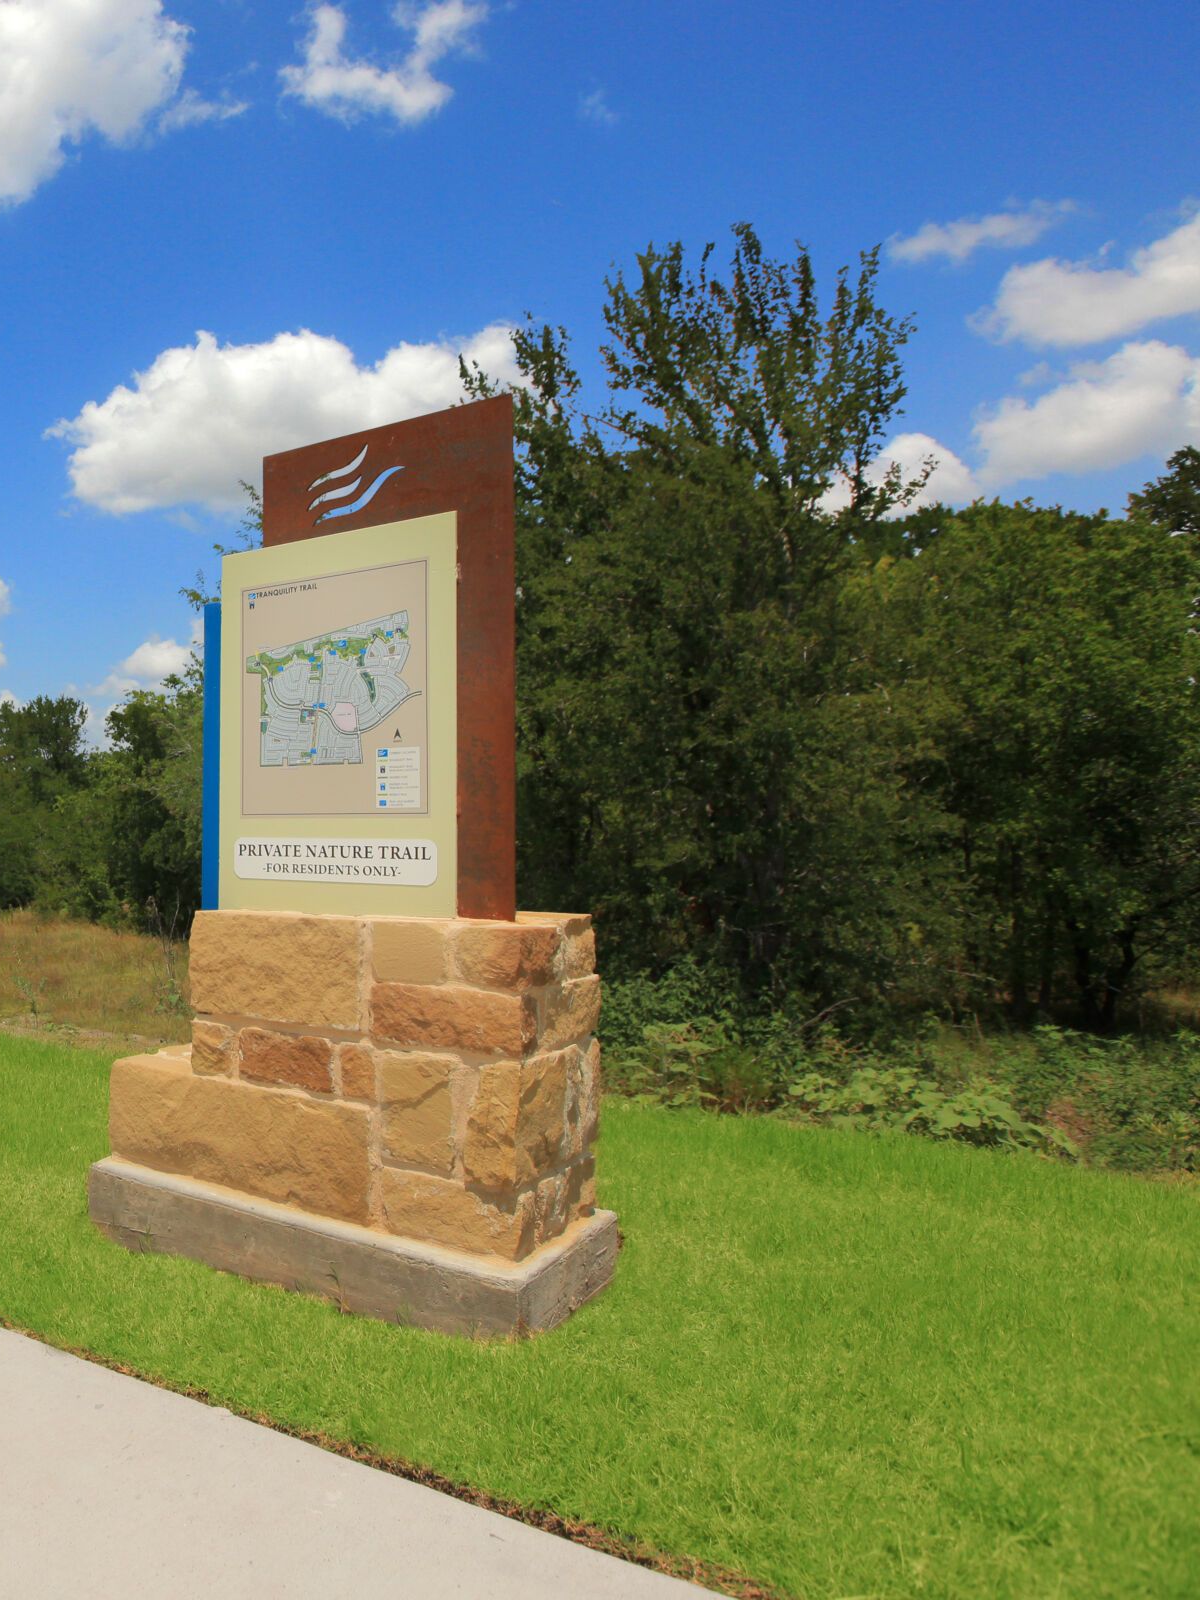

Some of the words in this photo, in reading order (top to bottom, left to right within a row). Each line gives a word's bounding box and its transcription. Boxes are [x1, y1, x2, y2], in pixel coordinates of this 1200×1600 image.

[256, 586, 298, 599] TRANQUILITY
[299, 583, 318, 592] TRAIL
[238, 844, 301, 857] PRIVATE
[306, 845, 373, 859] NATURE
[378, 845, 432, 861] TRAIL
[292, 863, 360, 876] RESIDENTS
